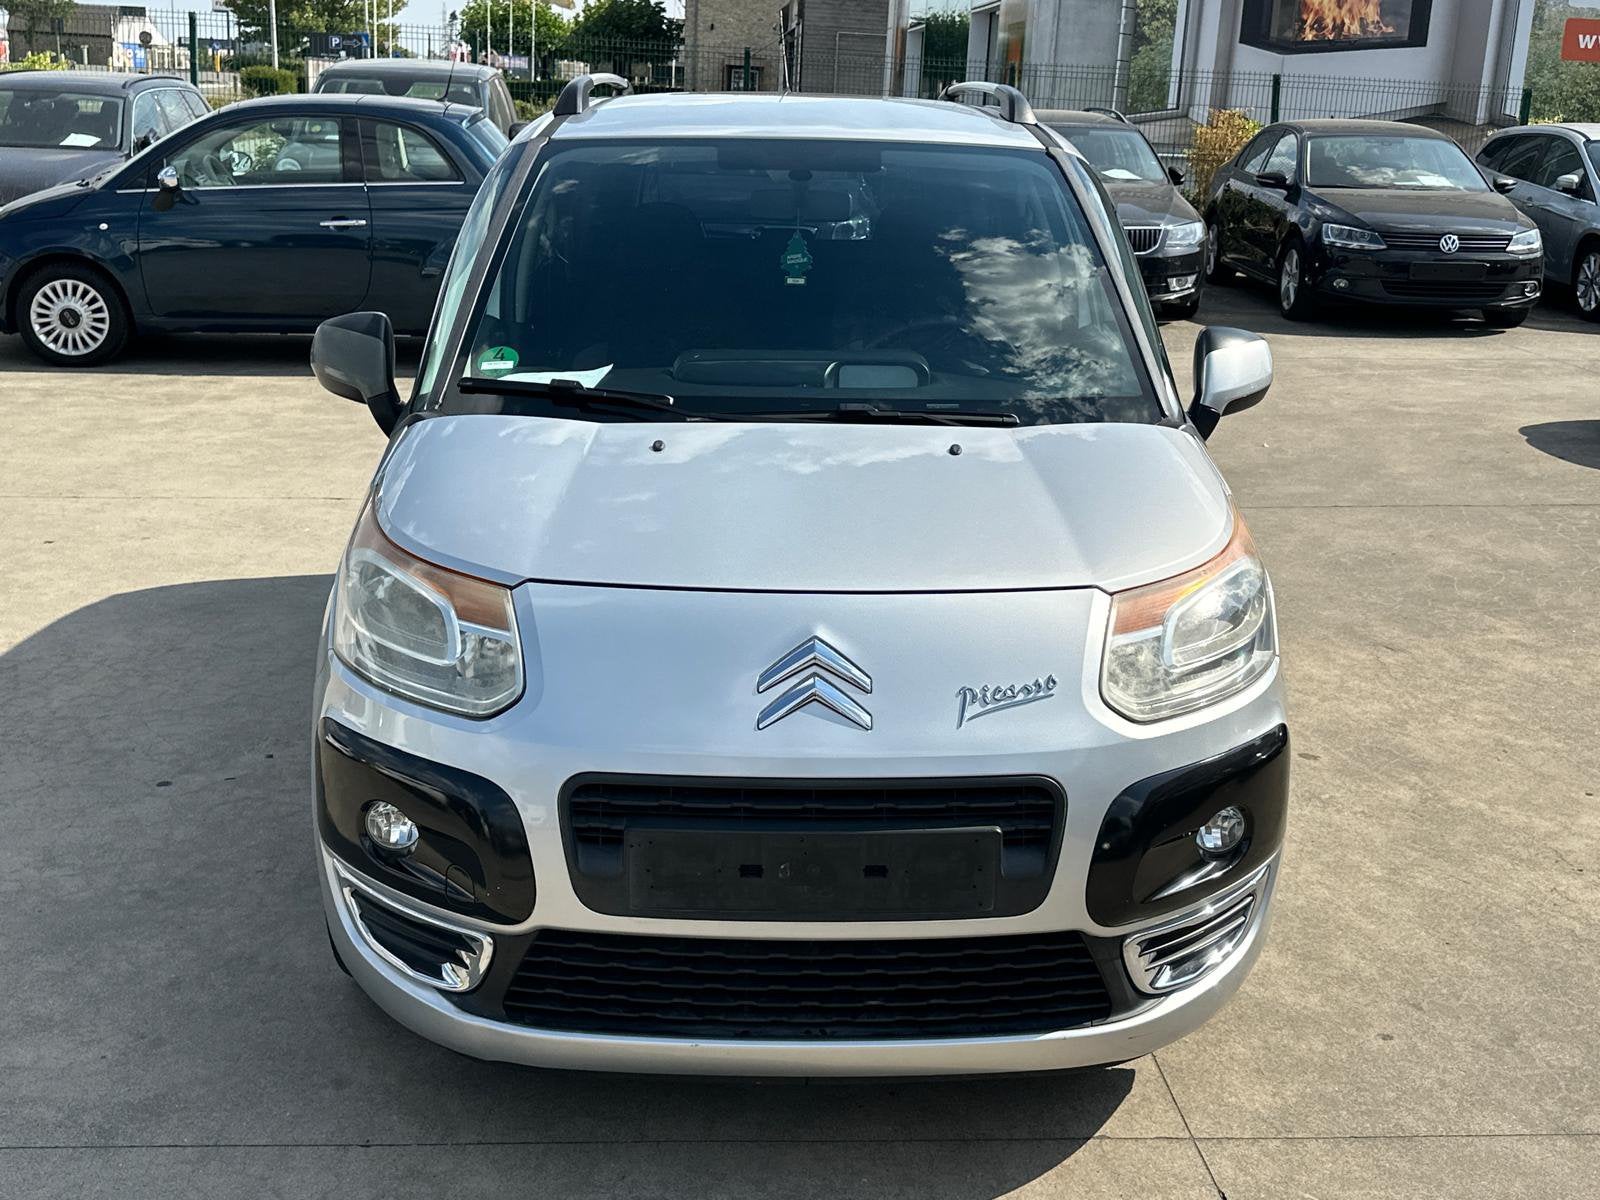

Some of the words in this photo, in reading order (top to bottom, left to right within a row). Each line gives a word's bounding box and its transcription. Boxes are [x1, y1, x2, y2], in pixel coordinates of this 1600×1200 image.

[331, 37, 340, 47] P
[1578, 33, 1600, 49] w
[493, 347, 505, 361] 4
